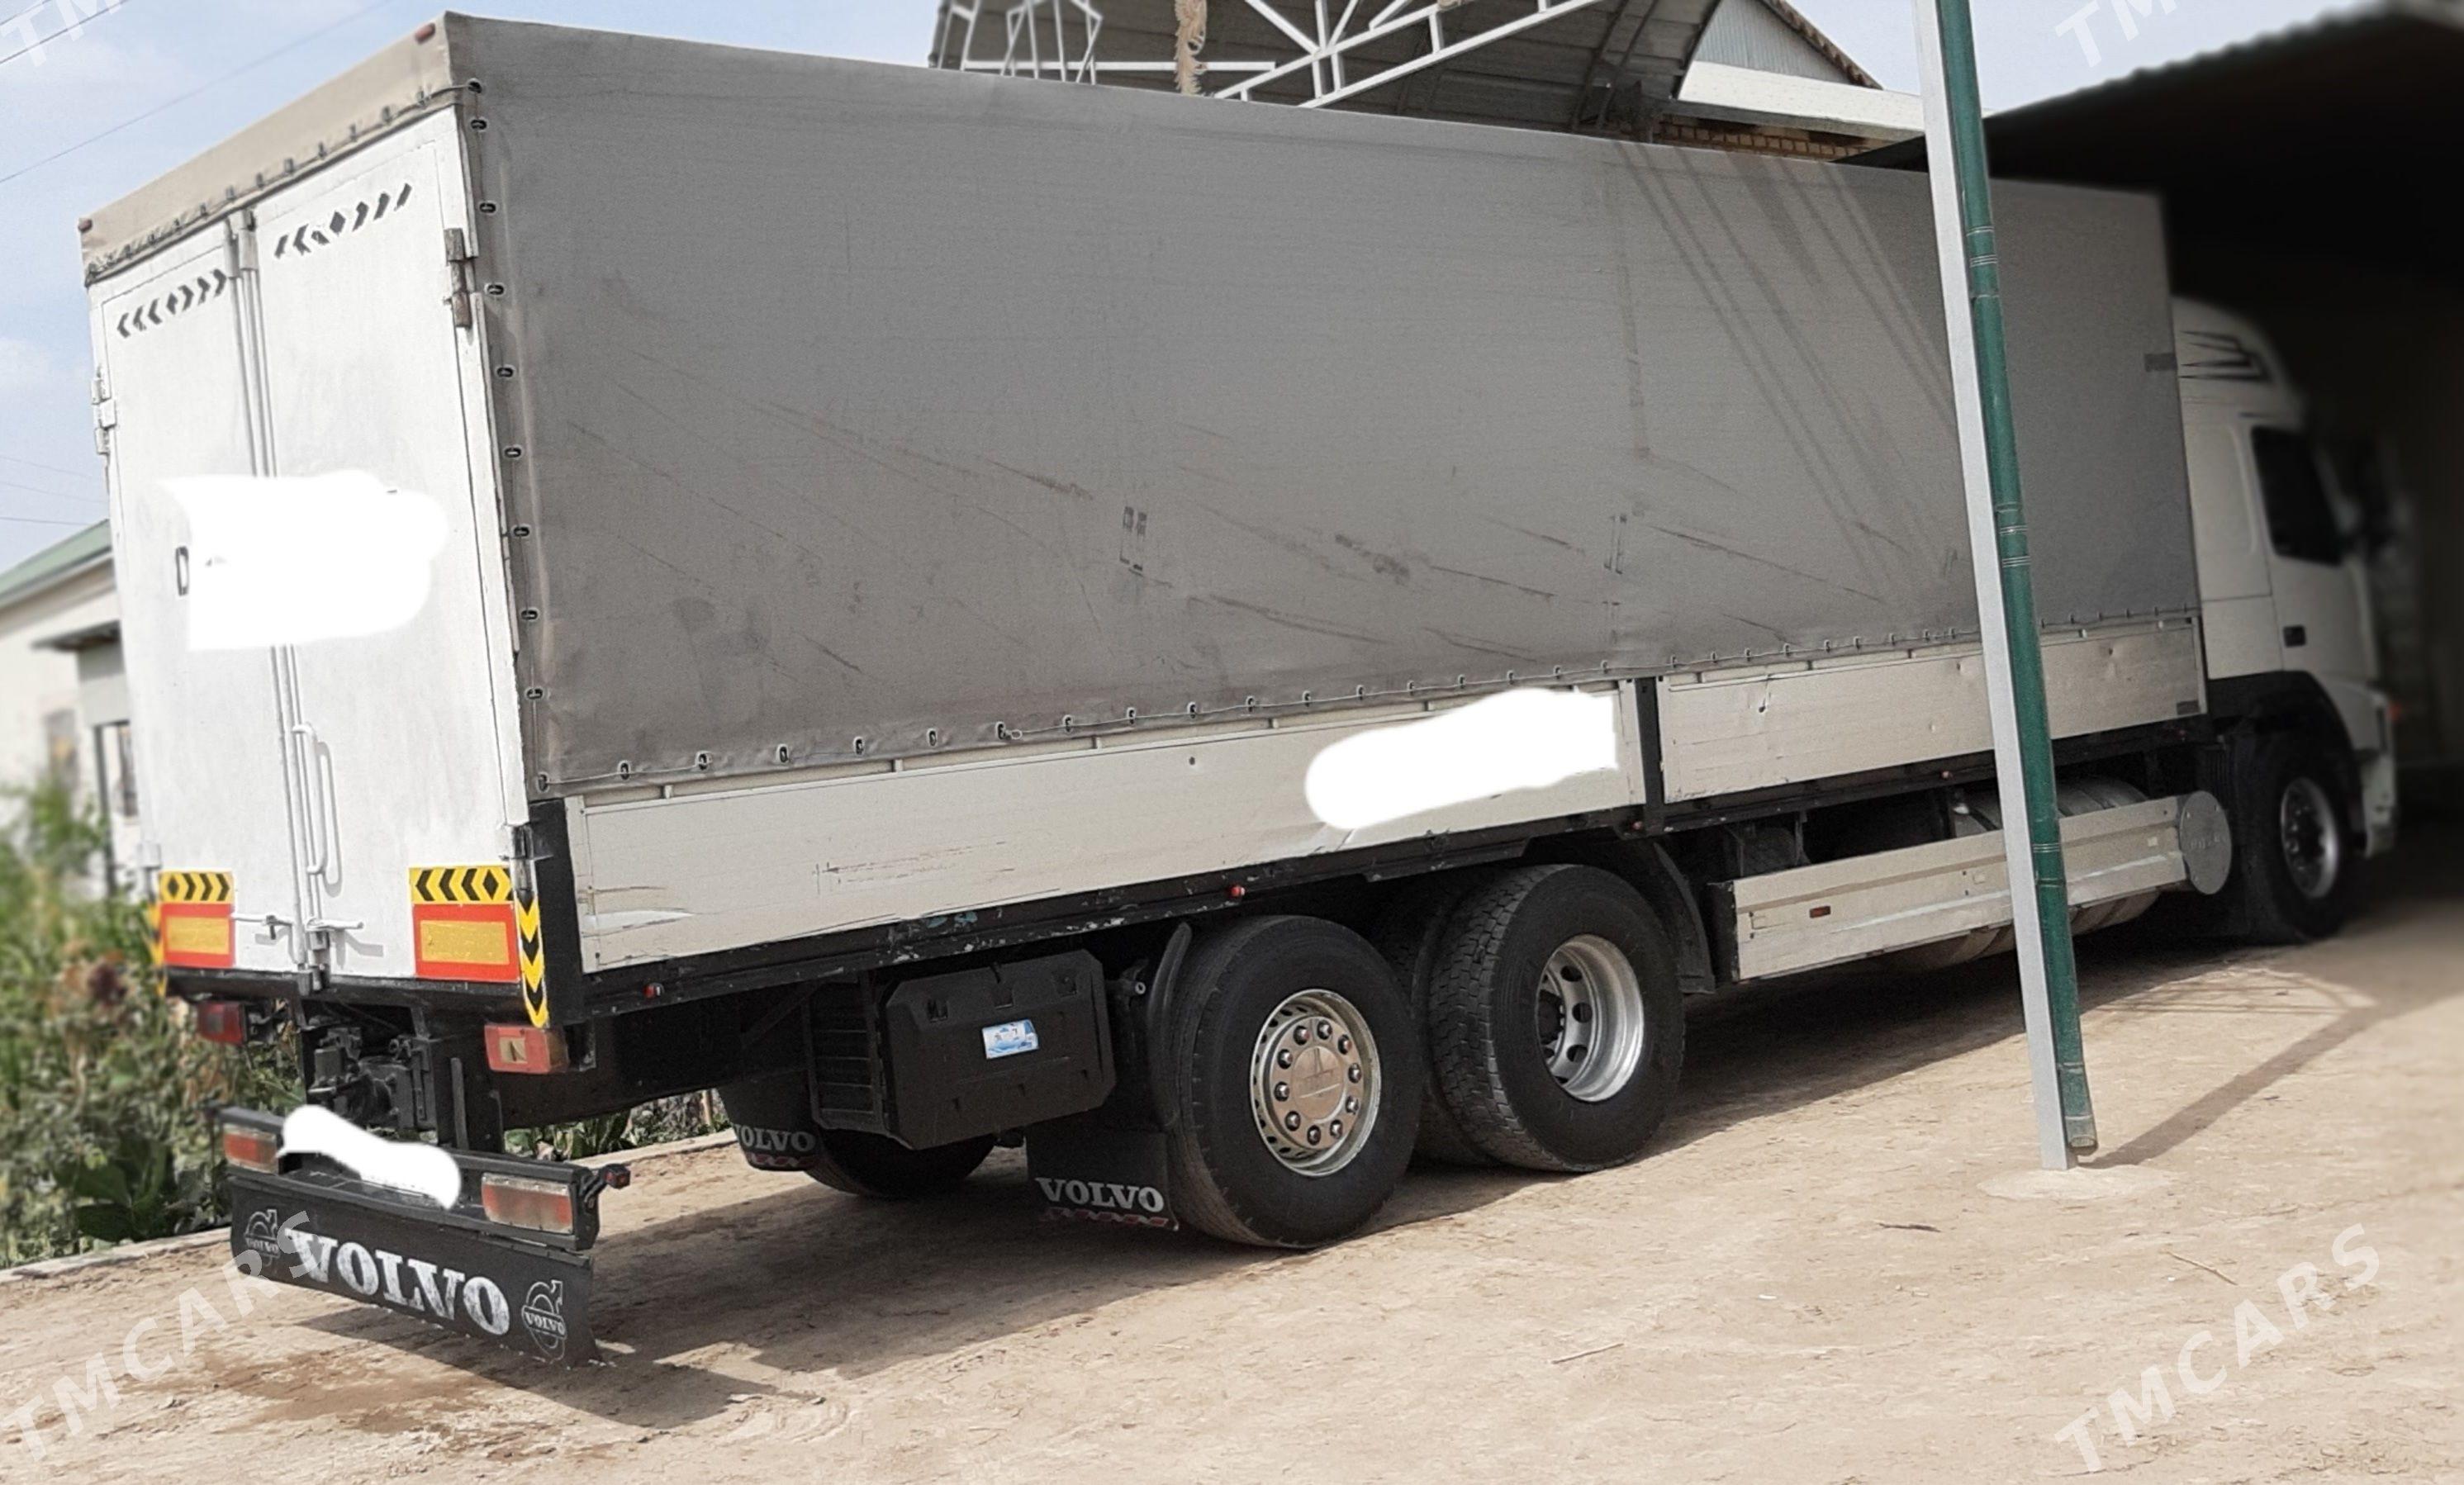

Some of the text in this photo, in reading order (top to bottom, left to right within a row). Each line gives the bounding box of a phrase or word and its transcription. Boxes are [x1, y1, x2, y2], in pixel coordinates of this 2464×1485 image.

[1034, 1177, 1165, 1213] VOLVO
[283, 1227, 510, 1336] VOLVO
[523, 1311, 567, 1336] VOLVO
